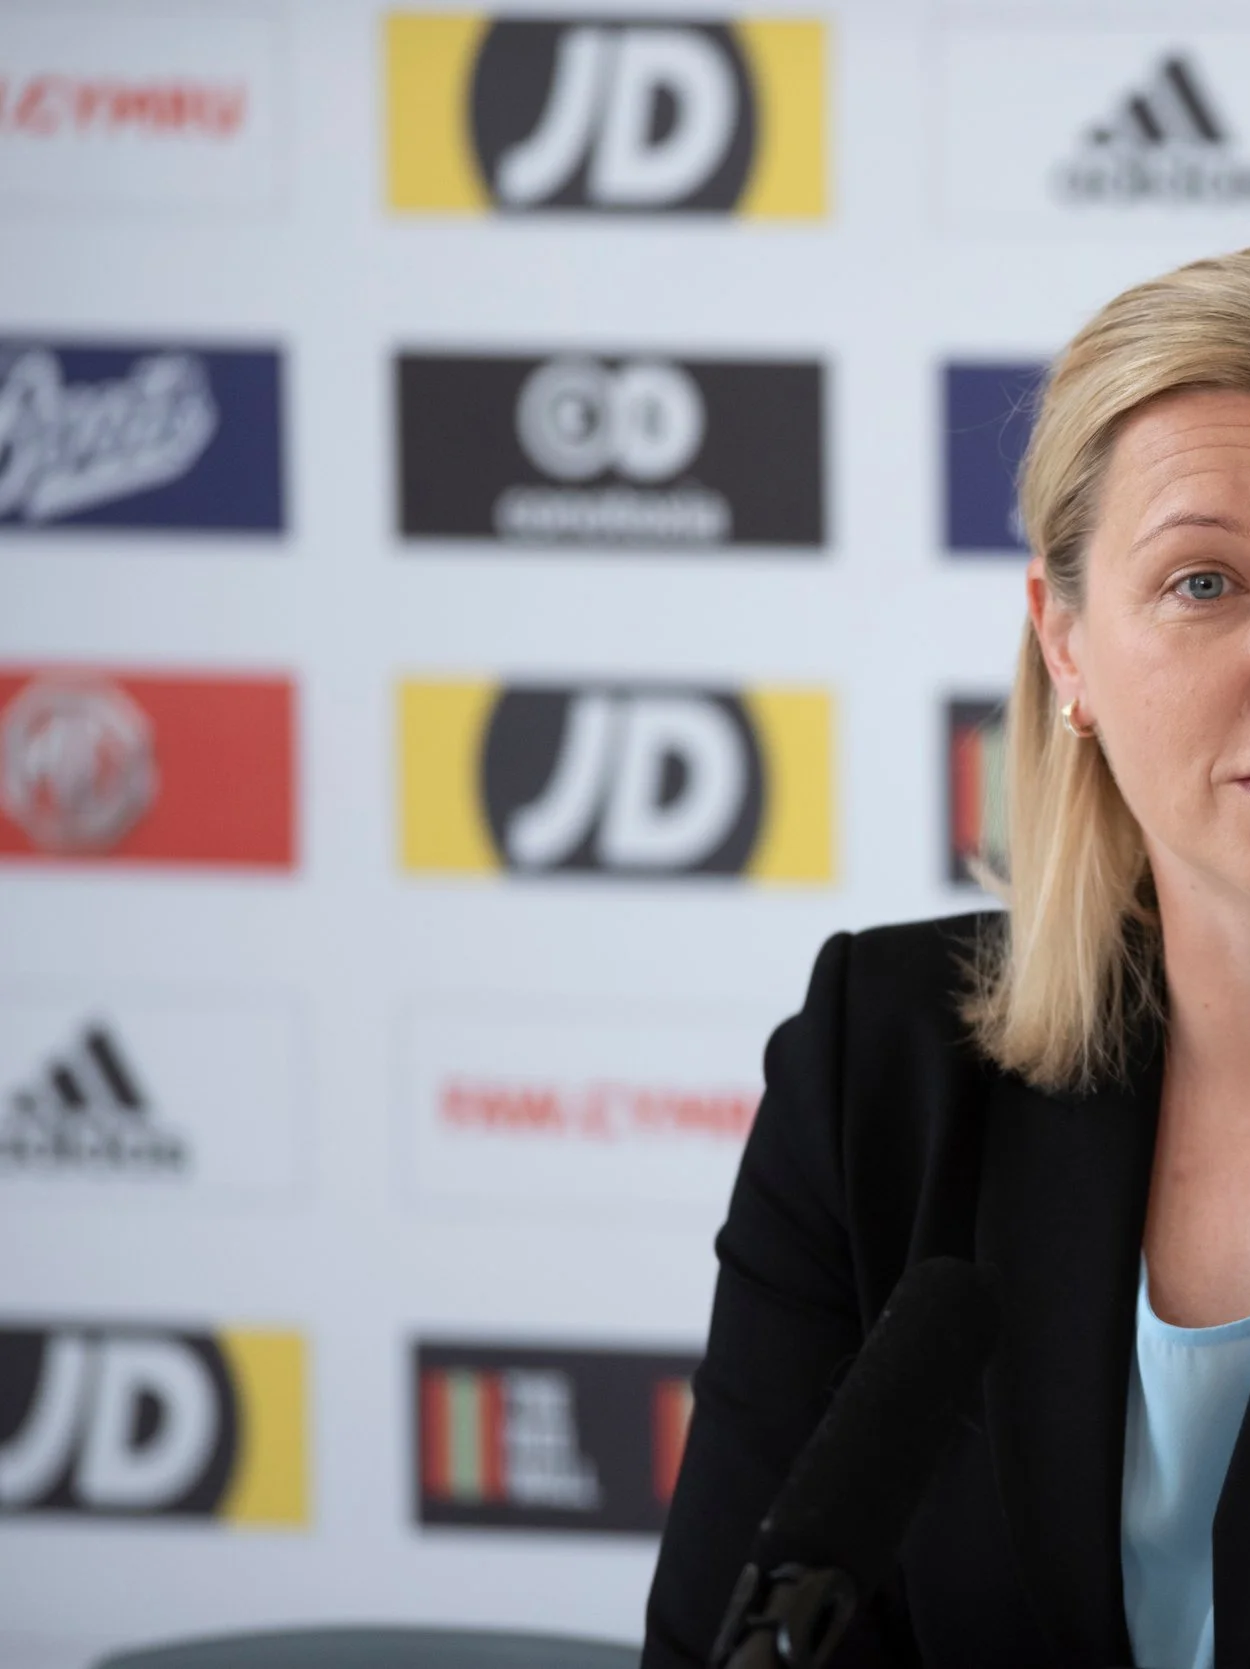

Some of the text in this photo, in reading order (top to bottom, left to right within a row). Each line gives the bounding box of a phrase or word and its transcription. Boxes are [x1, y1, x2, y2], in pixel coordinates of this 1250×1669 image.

[497, 25, 742, 207] JD
[506, 693, 750, 869] JD
[0, 1335, 222, 1509] JD
